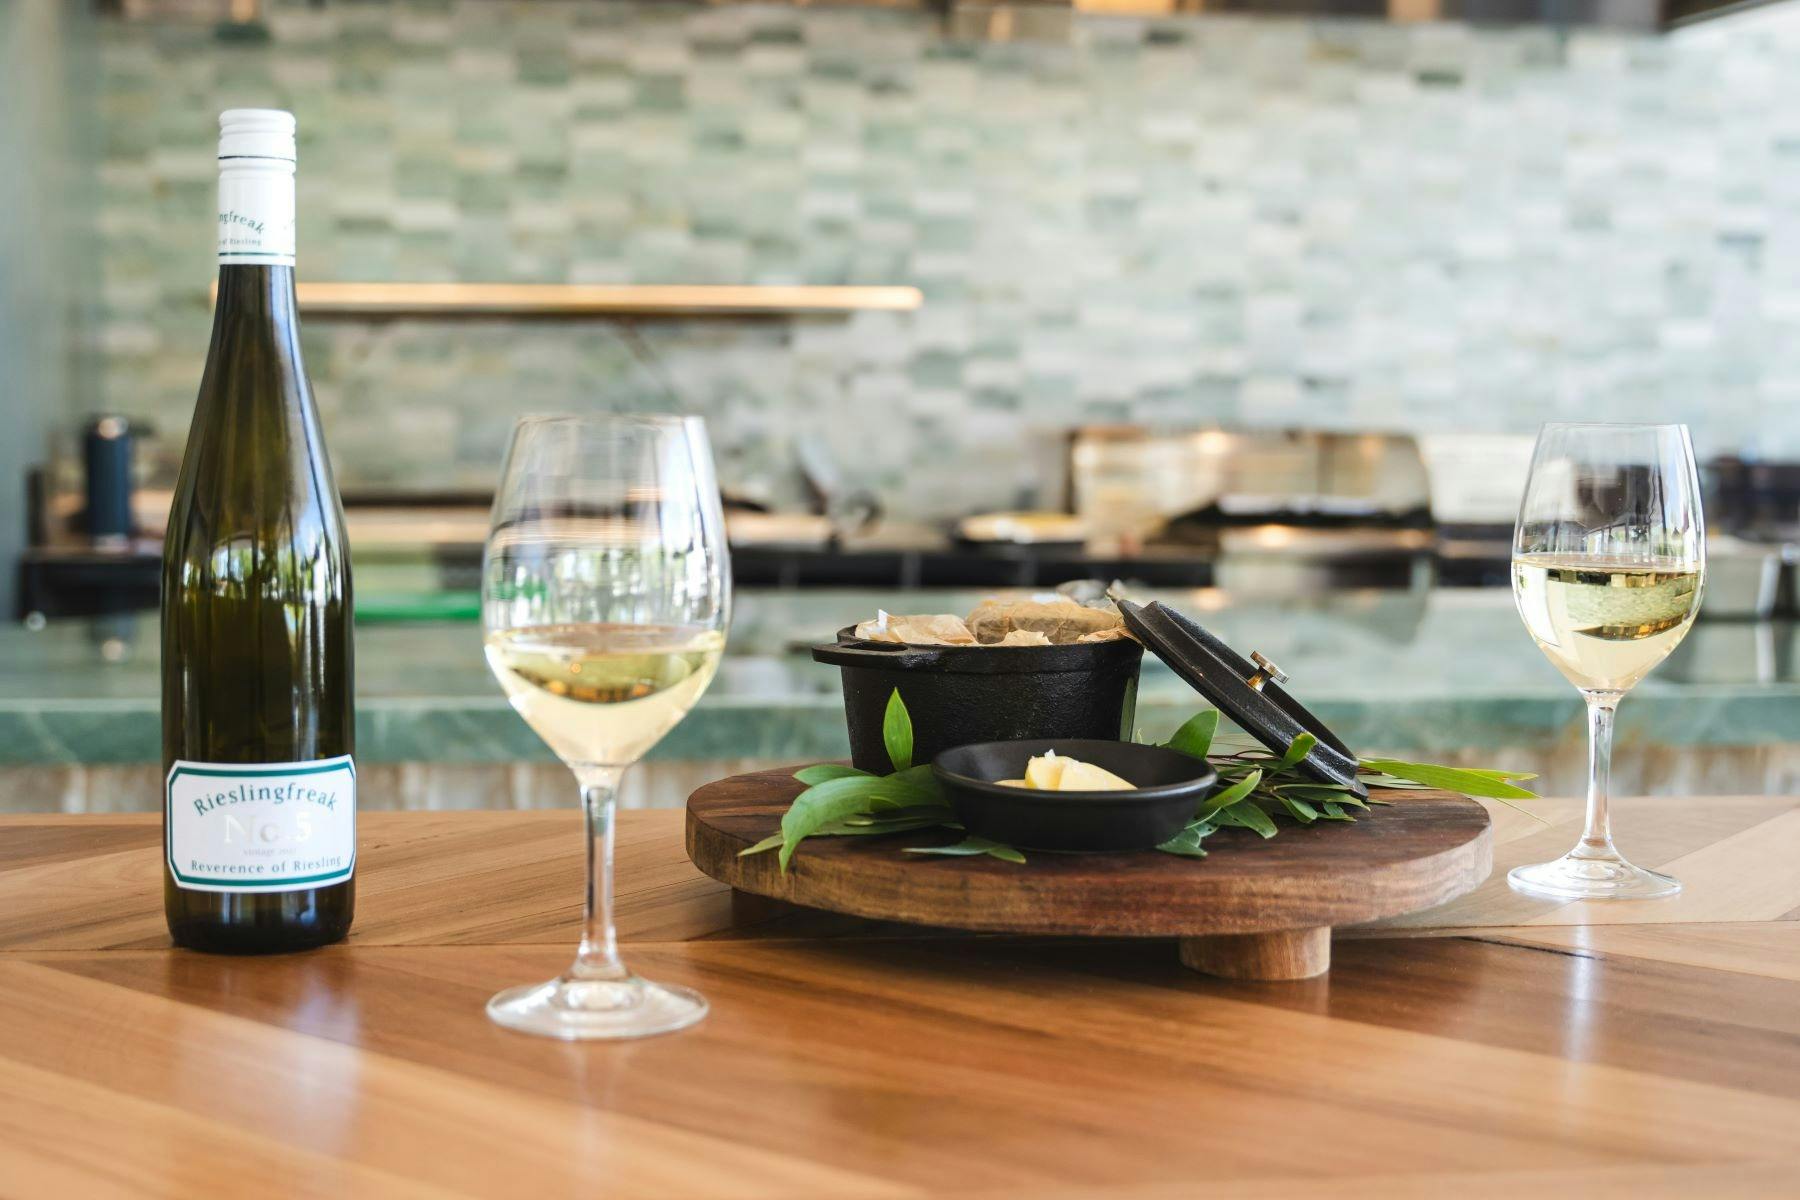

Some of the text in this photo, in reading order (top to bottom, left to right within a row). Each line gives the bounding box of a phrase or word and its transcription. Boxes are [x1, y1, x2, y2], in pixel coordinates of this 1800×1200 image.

[193, 782, 338, 816] Rieslingfreak
[191, 855, 342, 874] Reverence of Riesling
